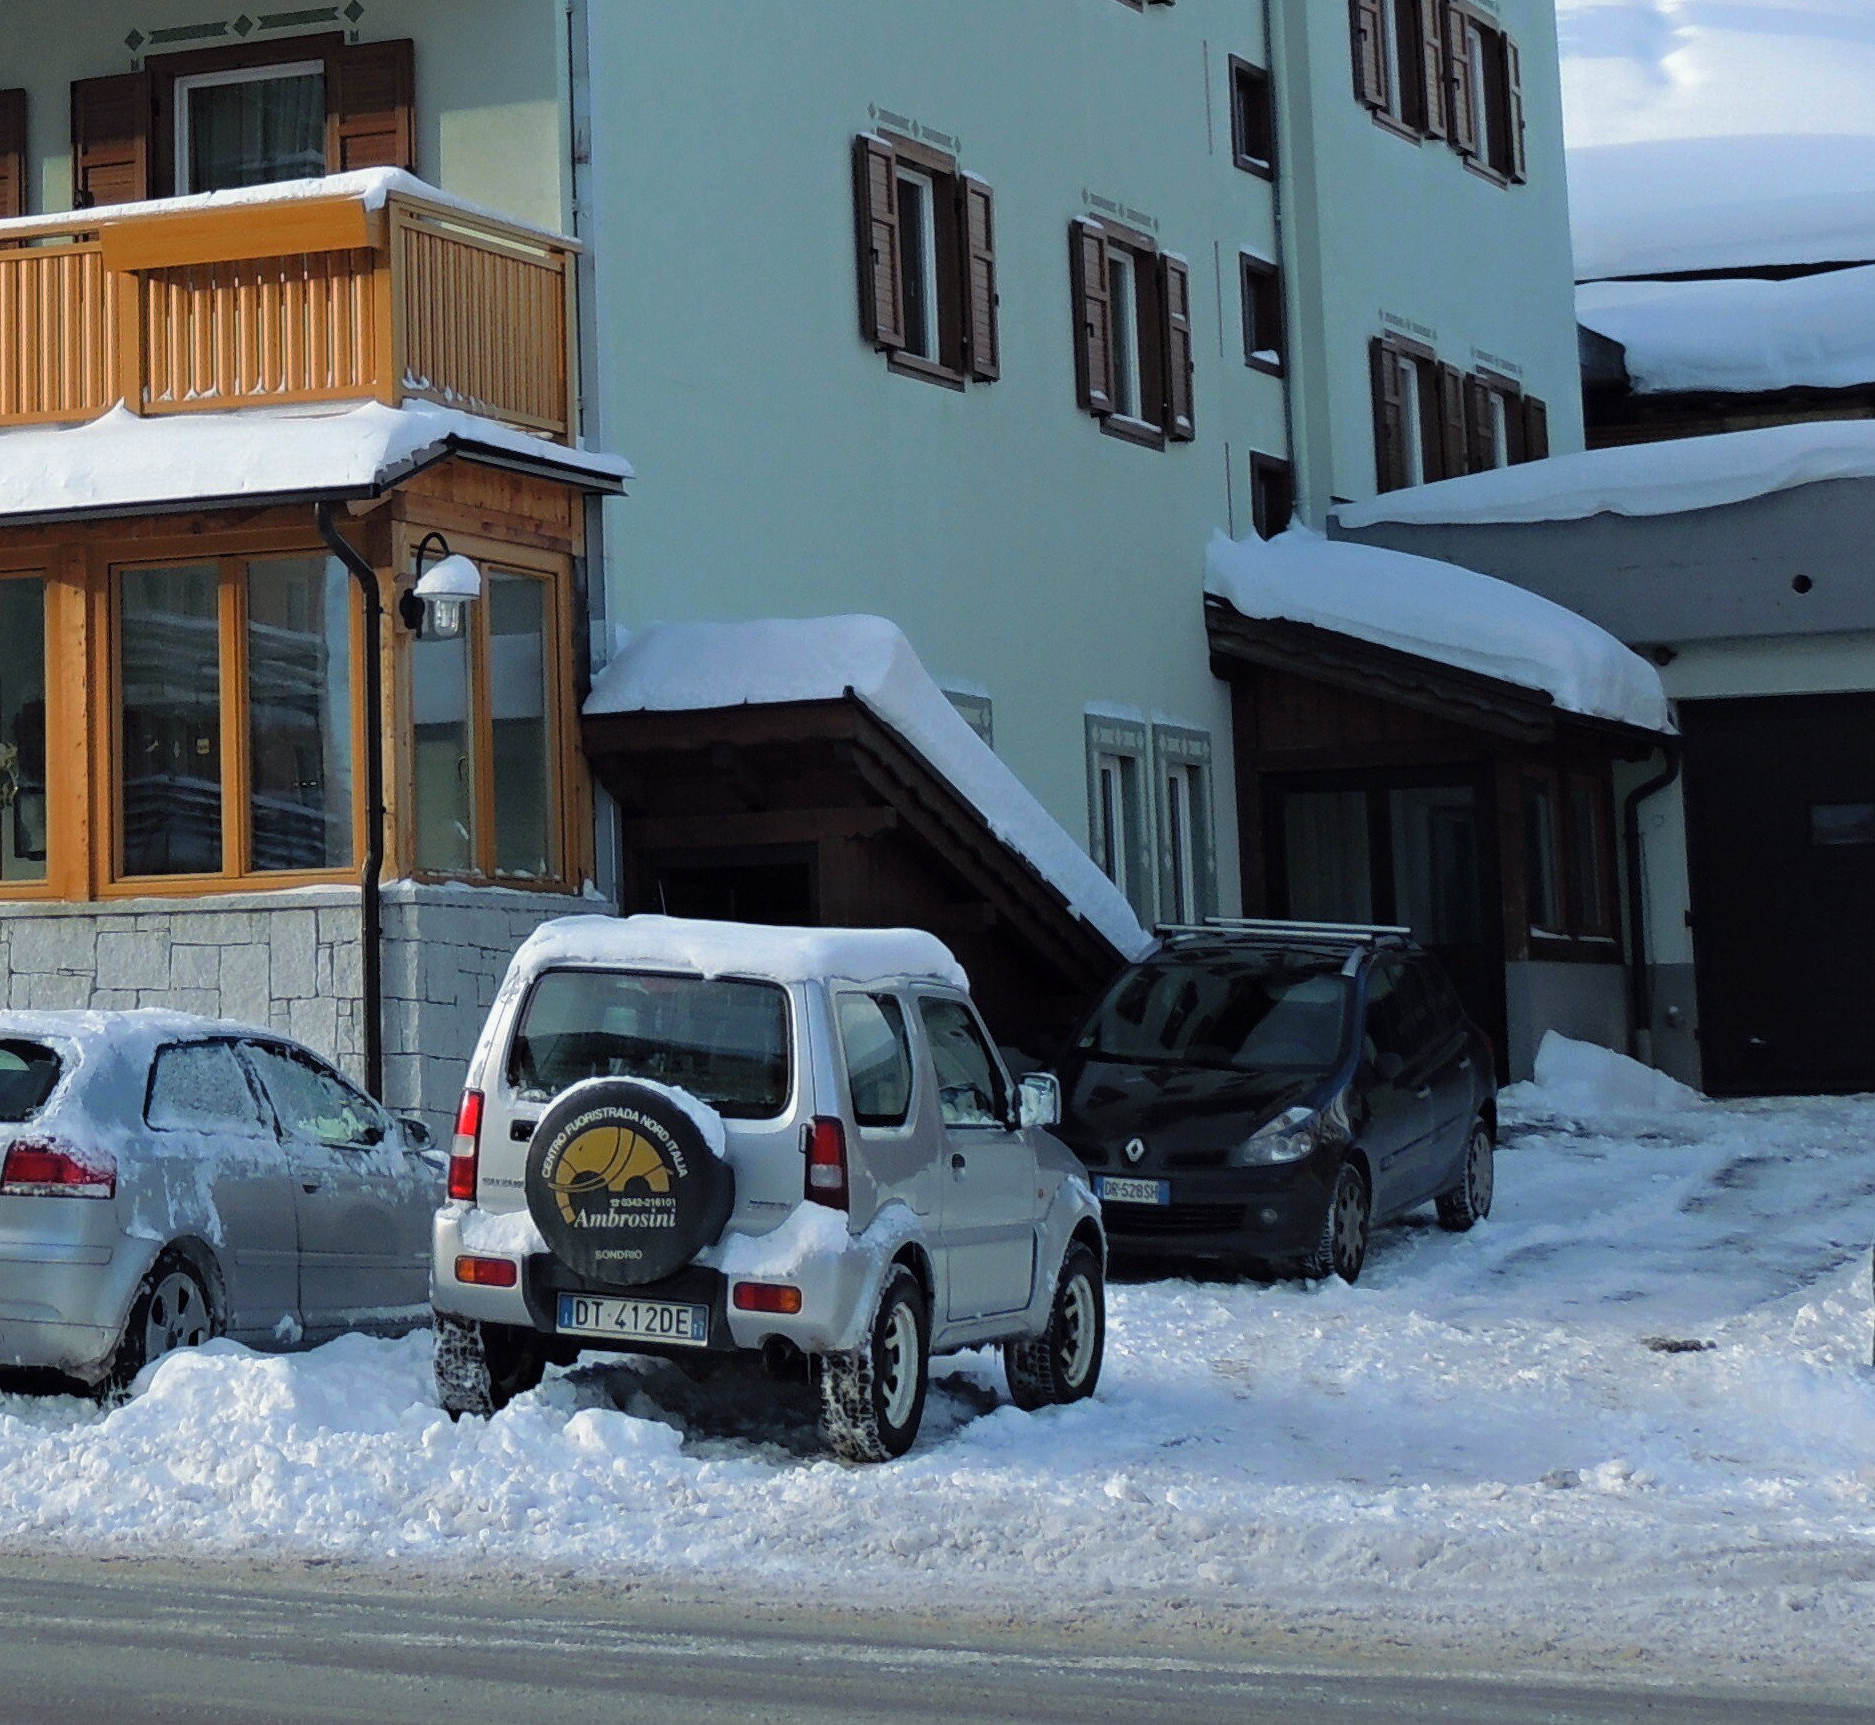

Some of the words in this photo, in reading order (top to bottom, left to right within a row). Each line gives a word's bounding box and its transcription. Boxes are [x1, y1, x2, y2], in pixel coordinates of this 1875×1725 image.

[541, 1132, 567, 1179] CENTRO
[565, 1107, 640, 1136] FUORISTRADA
[640, 1115, 670, 1142] NORD
[666, 1139, 688, 1179] ITALIA
[574, 1208, 676, 1228] Ambrosini
[595, 1249, 643, 1260] SONDRIO
[575, 1299, 603, 1327] DT
[615, 1303, 689, 1335] 412DE
